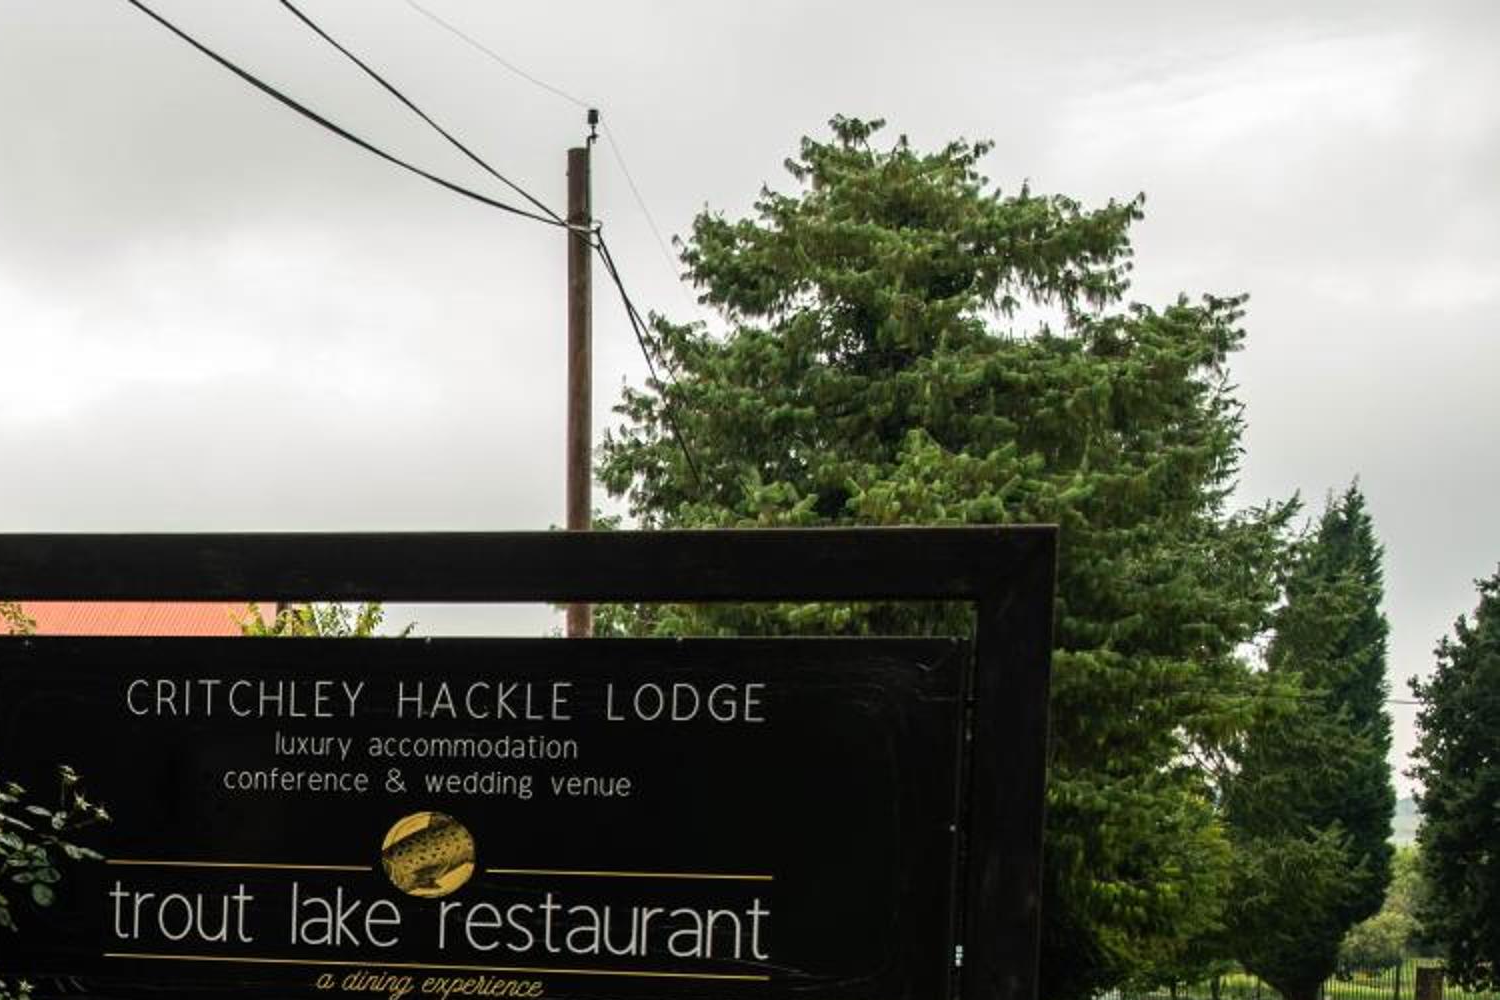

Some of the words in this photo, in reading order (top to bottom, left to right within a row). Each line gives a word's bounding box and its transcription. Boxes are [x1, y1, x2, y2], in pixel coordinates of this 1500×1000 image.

[127, 679, 365, 717] CRITCHLEY
[398, 681, 572, 720] HACKLE
[607, 683, 765, 722] LODGE
[275, 732, 352, 761] luxury
[369, 735, 577, 759] accommodation
[223, 767, 369, 792] conference
[385, 767, 406, 793] &
[425, 771, 533, 799] wedding
[551, 776, 631, 797] venue
[109, 880, 254, 943] trout
[290, 880, 401, 947] lake
[439, 890, 770, 961] restaurant
[315, 973, 335, 989] a
